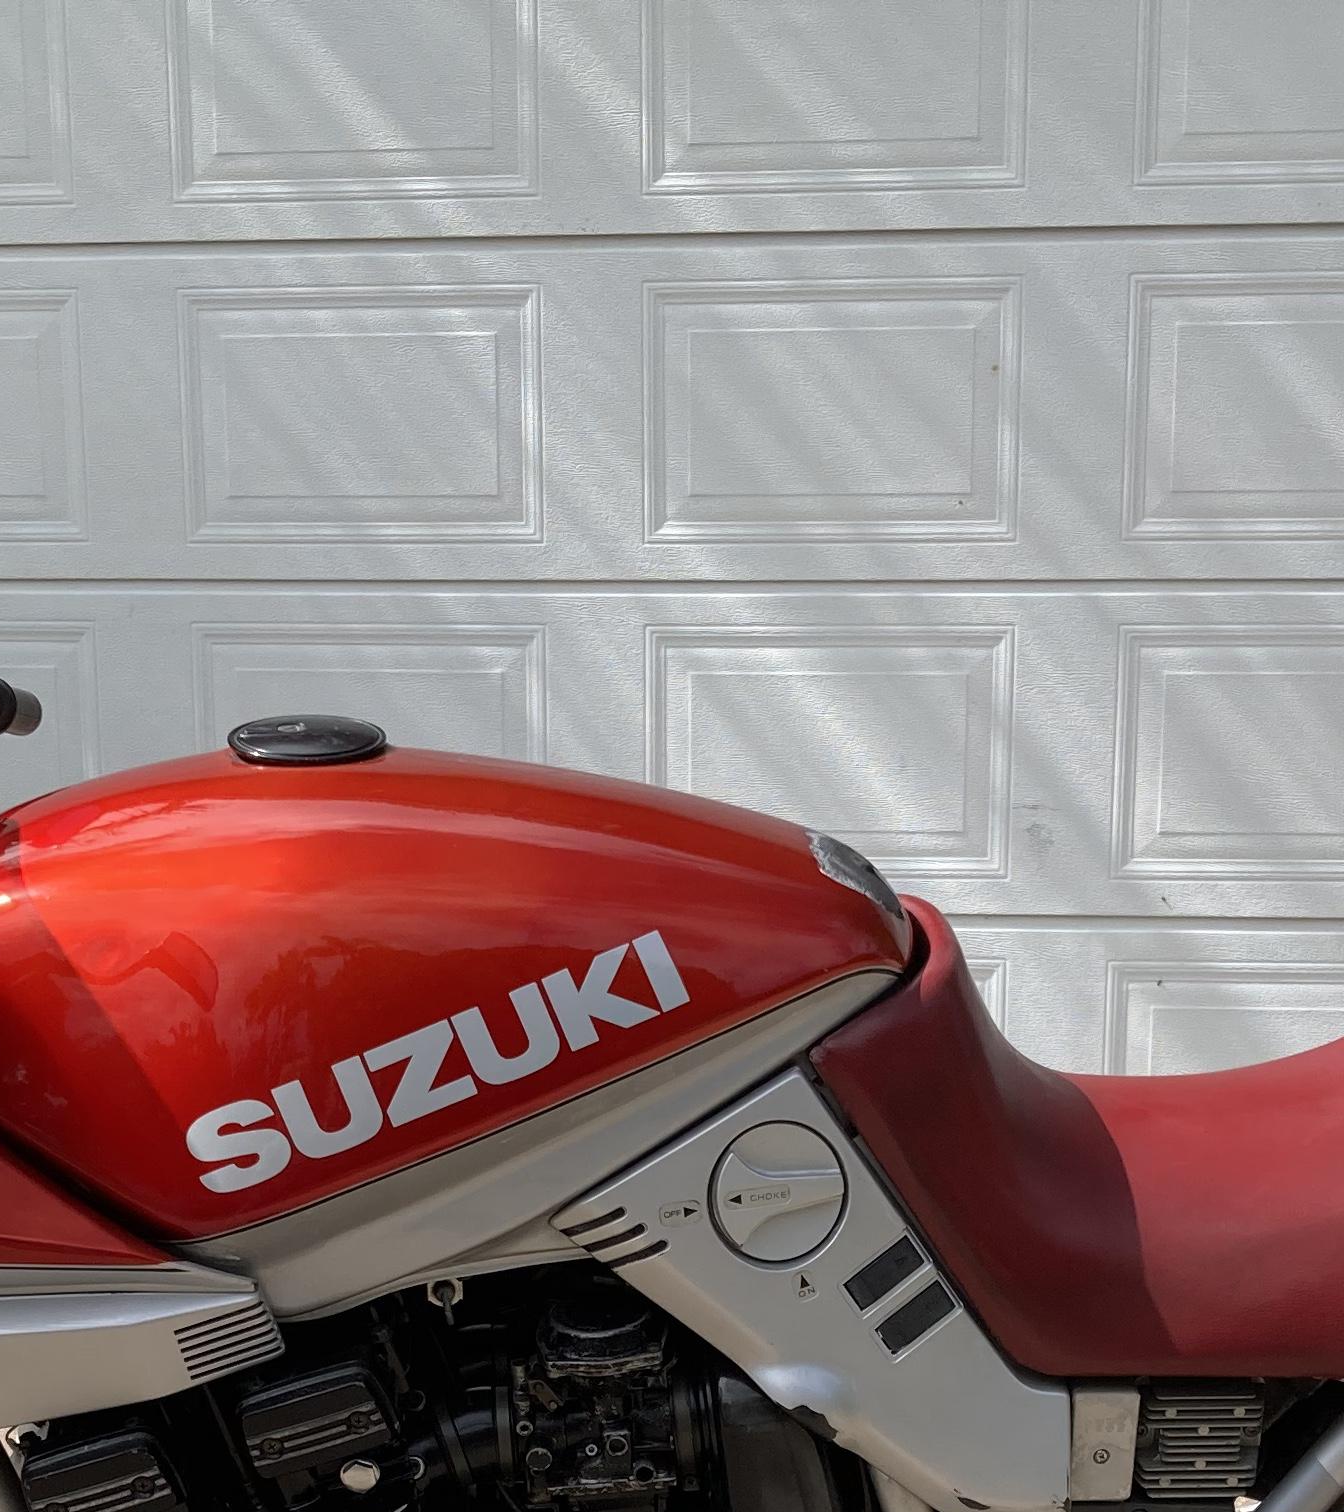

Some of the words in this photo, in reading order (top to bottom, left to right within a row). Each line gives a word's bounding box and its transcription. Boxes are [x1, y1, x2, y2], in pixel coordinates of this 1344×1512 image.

[186, 929, 691, 1194] SUZUKI
[749, 1191, 788, 1202] CHOKE
[663, 1209, 682, 1219] OFF
[798, 1287, 816, 1298] ON
